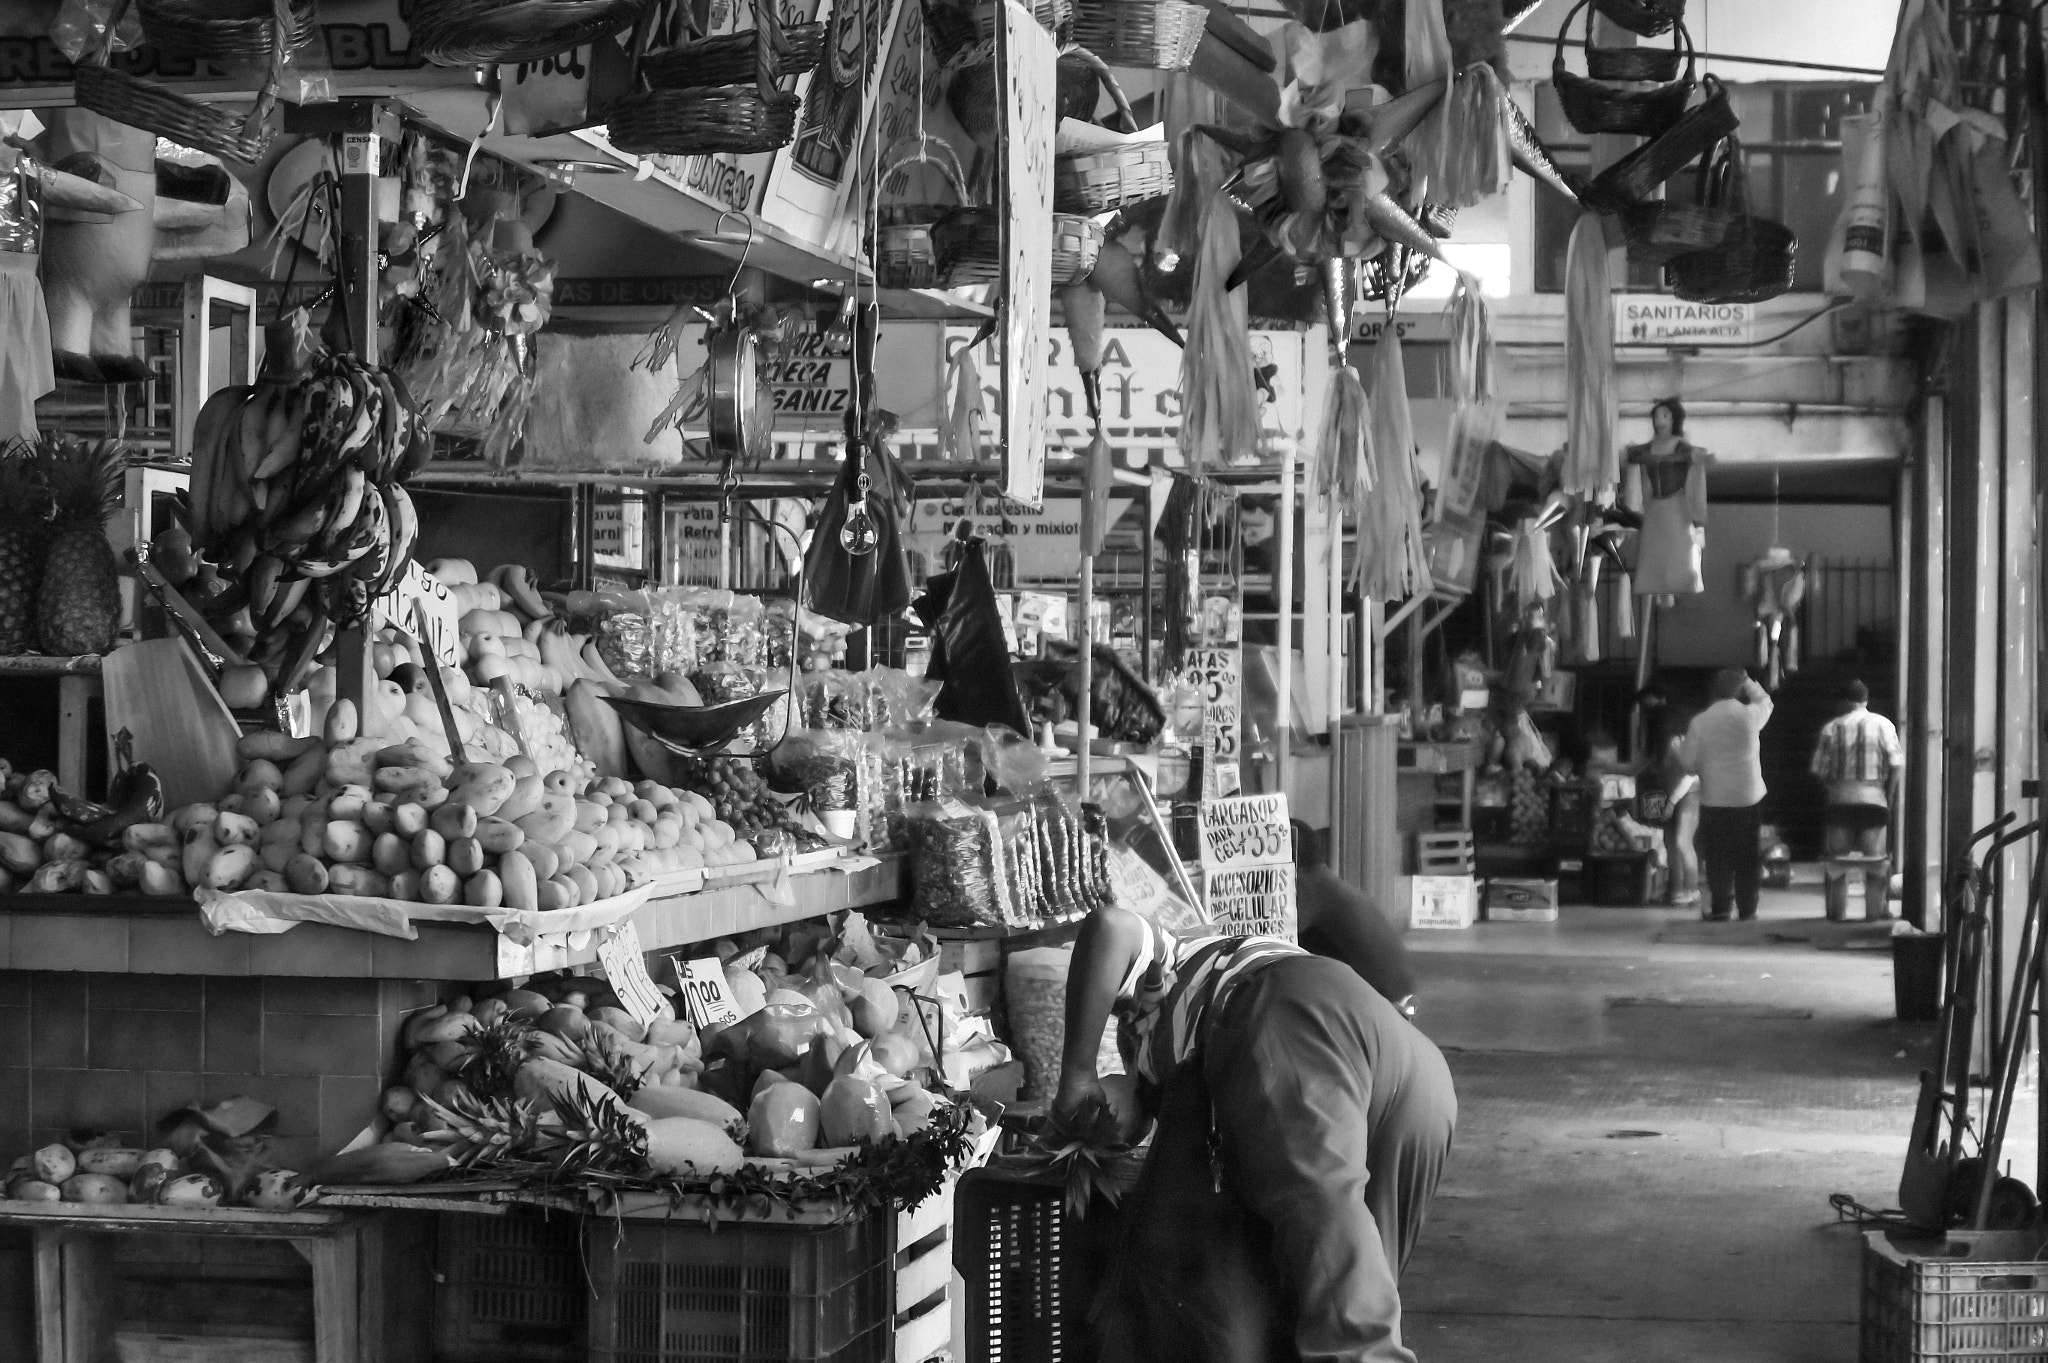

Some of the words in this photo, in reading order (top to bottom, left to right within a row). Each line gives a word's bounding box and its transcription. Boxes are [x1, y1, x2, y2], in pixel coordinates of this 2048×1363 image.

[1627, 304, 1745, 321] SANITARIOS
[1359, 322, 1416, 338] ORS"
[1022, 523, 1031, 538] y
[1207, 826, 1236, 849] PARA
[1209, 869, 1288, 899] ACCESORIOS
[1228, 894, 1290, 922] CELULAR
[1218, 919, 1285, 937] ARGADORES
